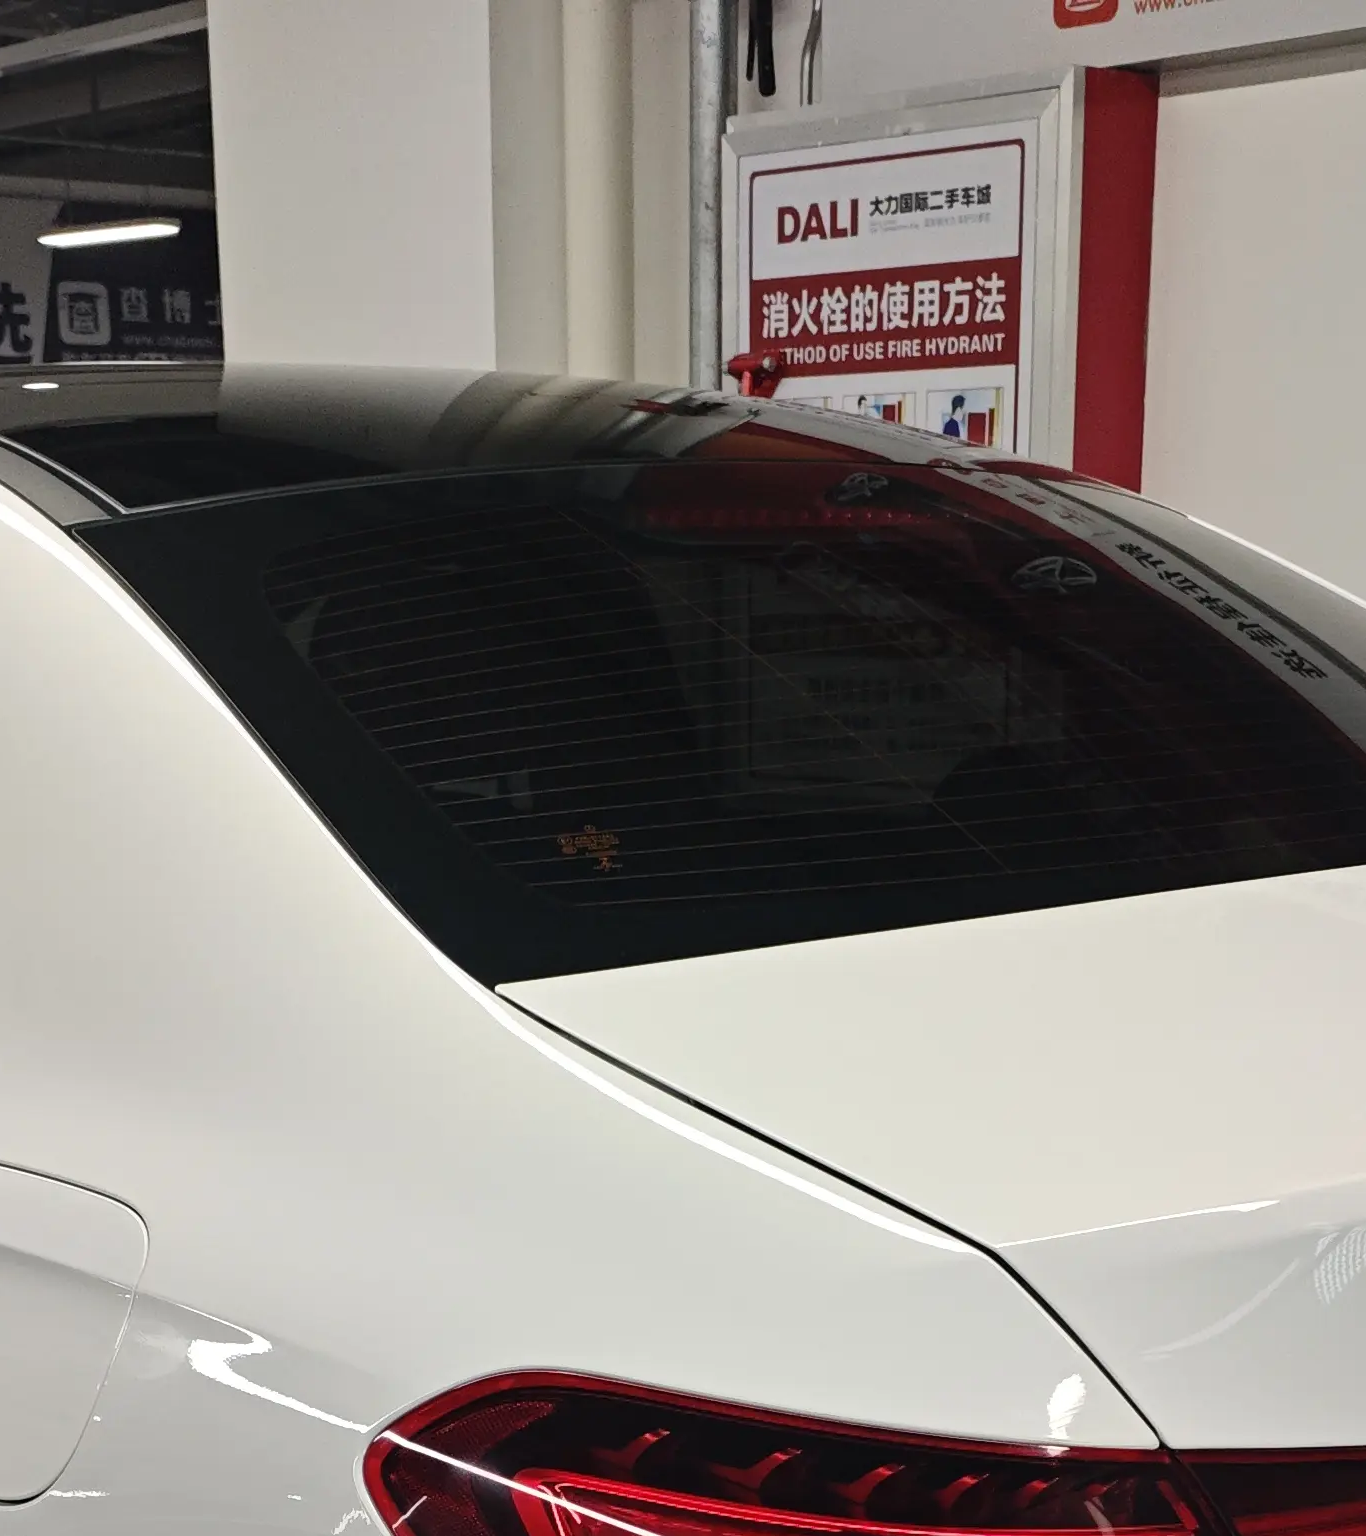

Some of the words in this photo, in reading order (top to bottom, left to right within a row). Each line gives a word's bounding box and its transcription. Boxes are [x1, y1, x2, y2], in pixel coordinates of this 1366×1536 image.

[869, 184, 992, 217] 大力国际二手车城
[778, 198, 859, 245] DALI
[761, 272, 1007, 339] 消火栓的使用方法
[782, 346, 826, 366] THOD
[829, 343, 850, 363] OF
[852, 340, 884, 361] USE
[887, 338, 921, 359] FIRE
[924, 333, 1006, 356] HYDRANT
